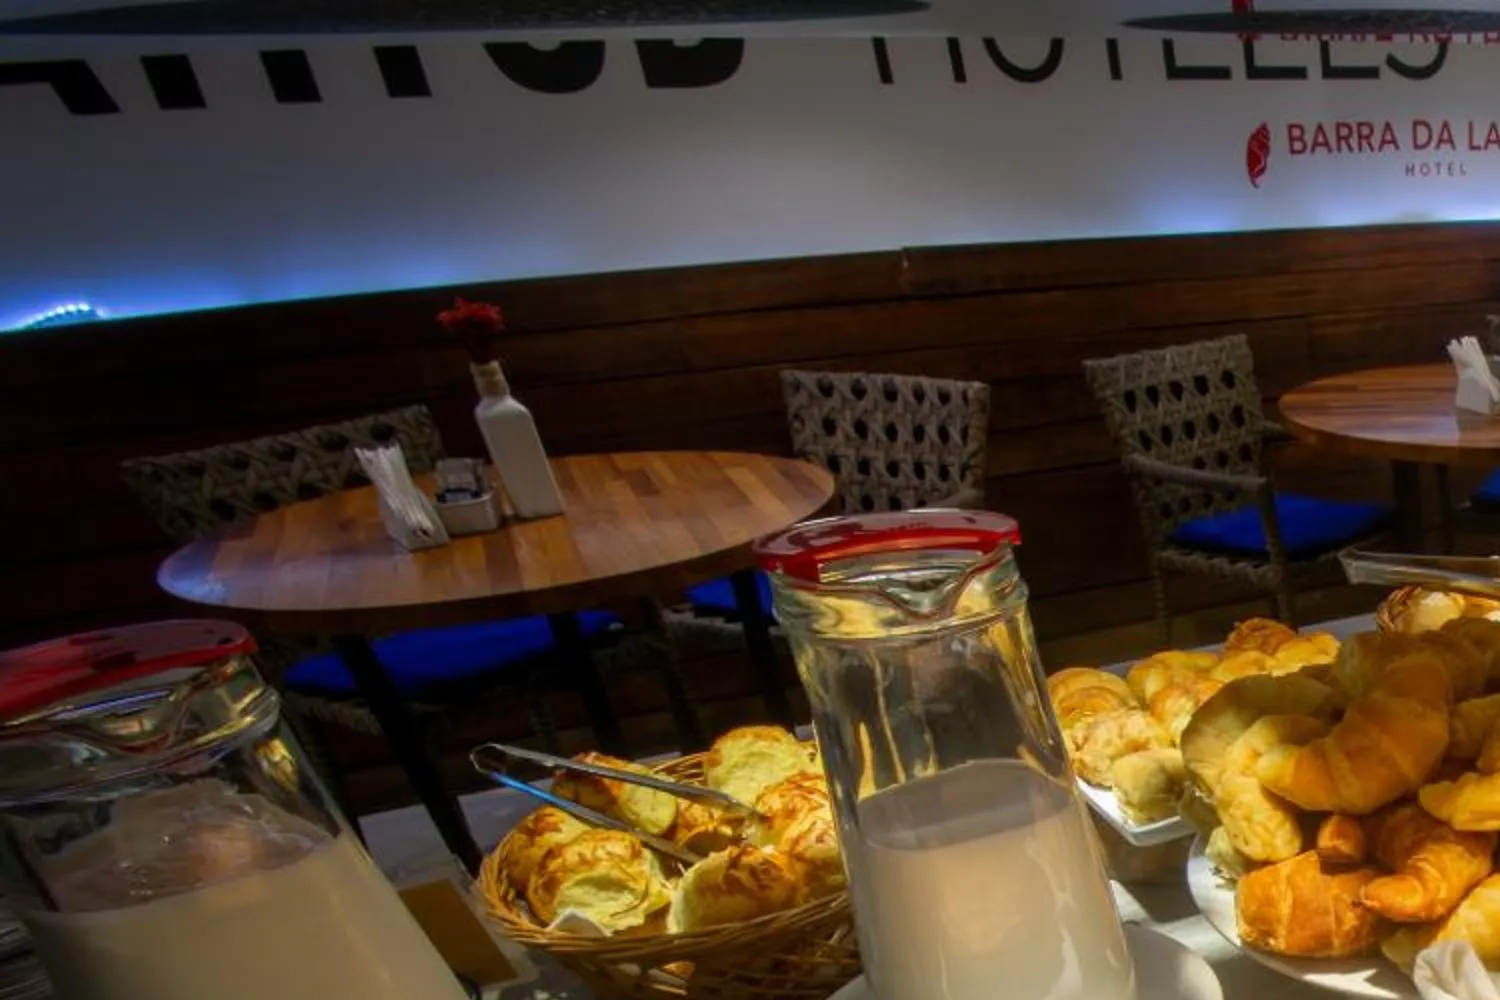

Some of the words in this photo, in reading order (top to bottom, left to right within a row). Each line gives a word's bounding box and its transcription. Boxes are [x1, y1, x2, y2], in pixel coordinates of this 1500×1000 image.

[1286, 121, 1401, 155] BARRA
[1411, 119, 1457, 152] DA
[1404, 162, 1468, 178] HOTEL
